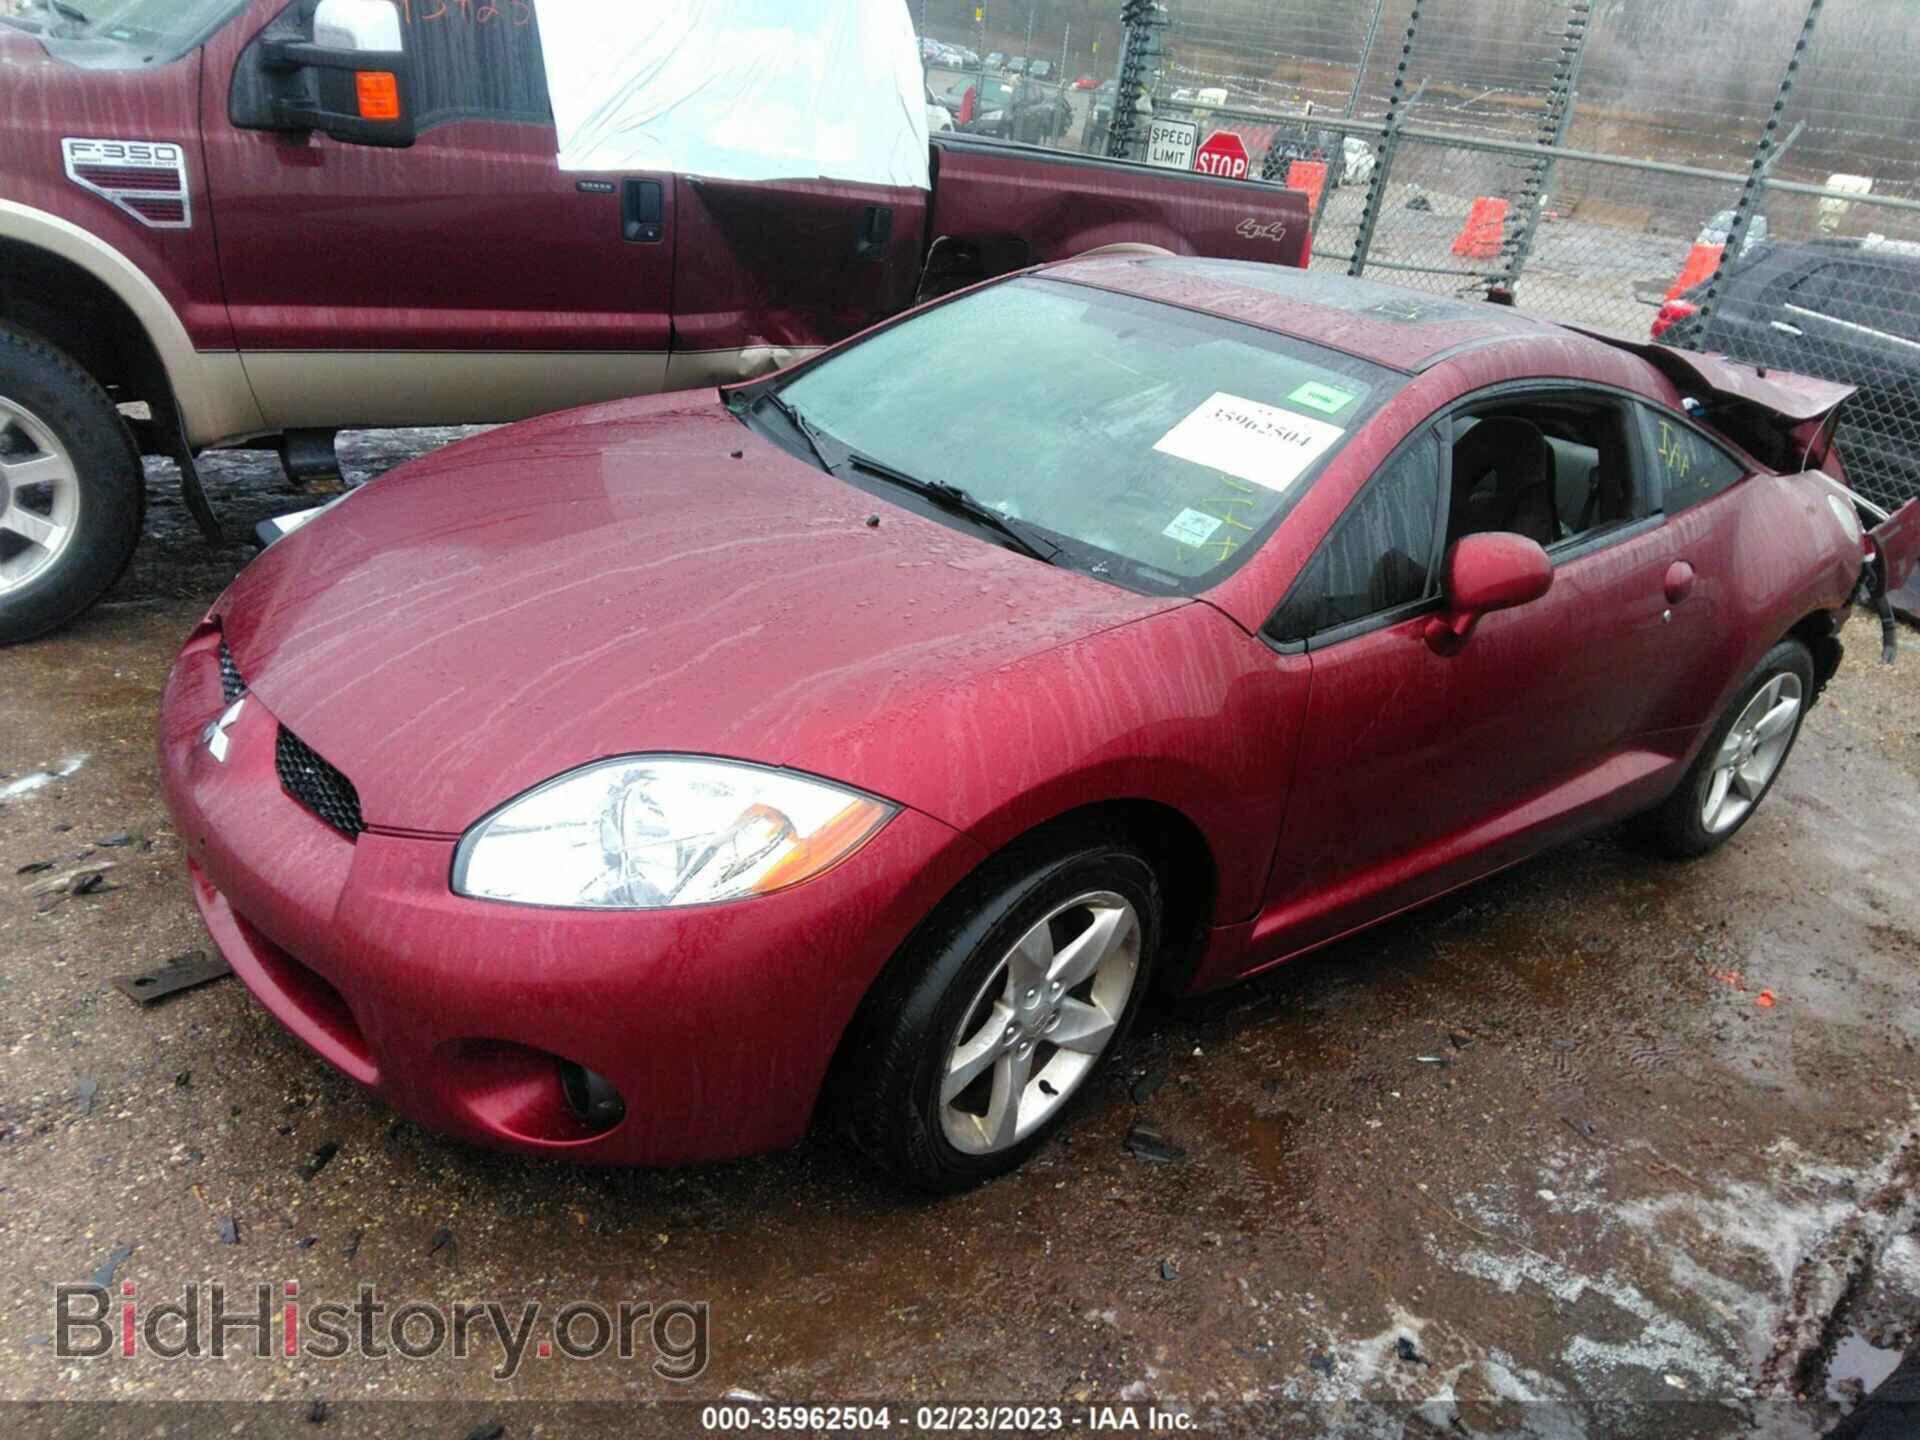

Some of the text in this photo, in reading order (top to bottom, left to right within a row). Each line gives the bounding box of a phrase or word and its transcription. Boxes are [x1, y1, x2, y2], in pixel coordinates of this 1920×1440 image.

[1152, 128, 1192, 146] SPEED
[1153, 147, 1185, 165] LIMIT
[1199, 151, 1246, 178] STOP
